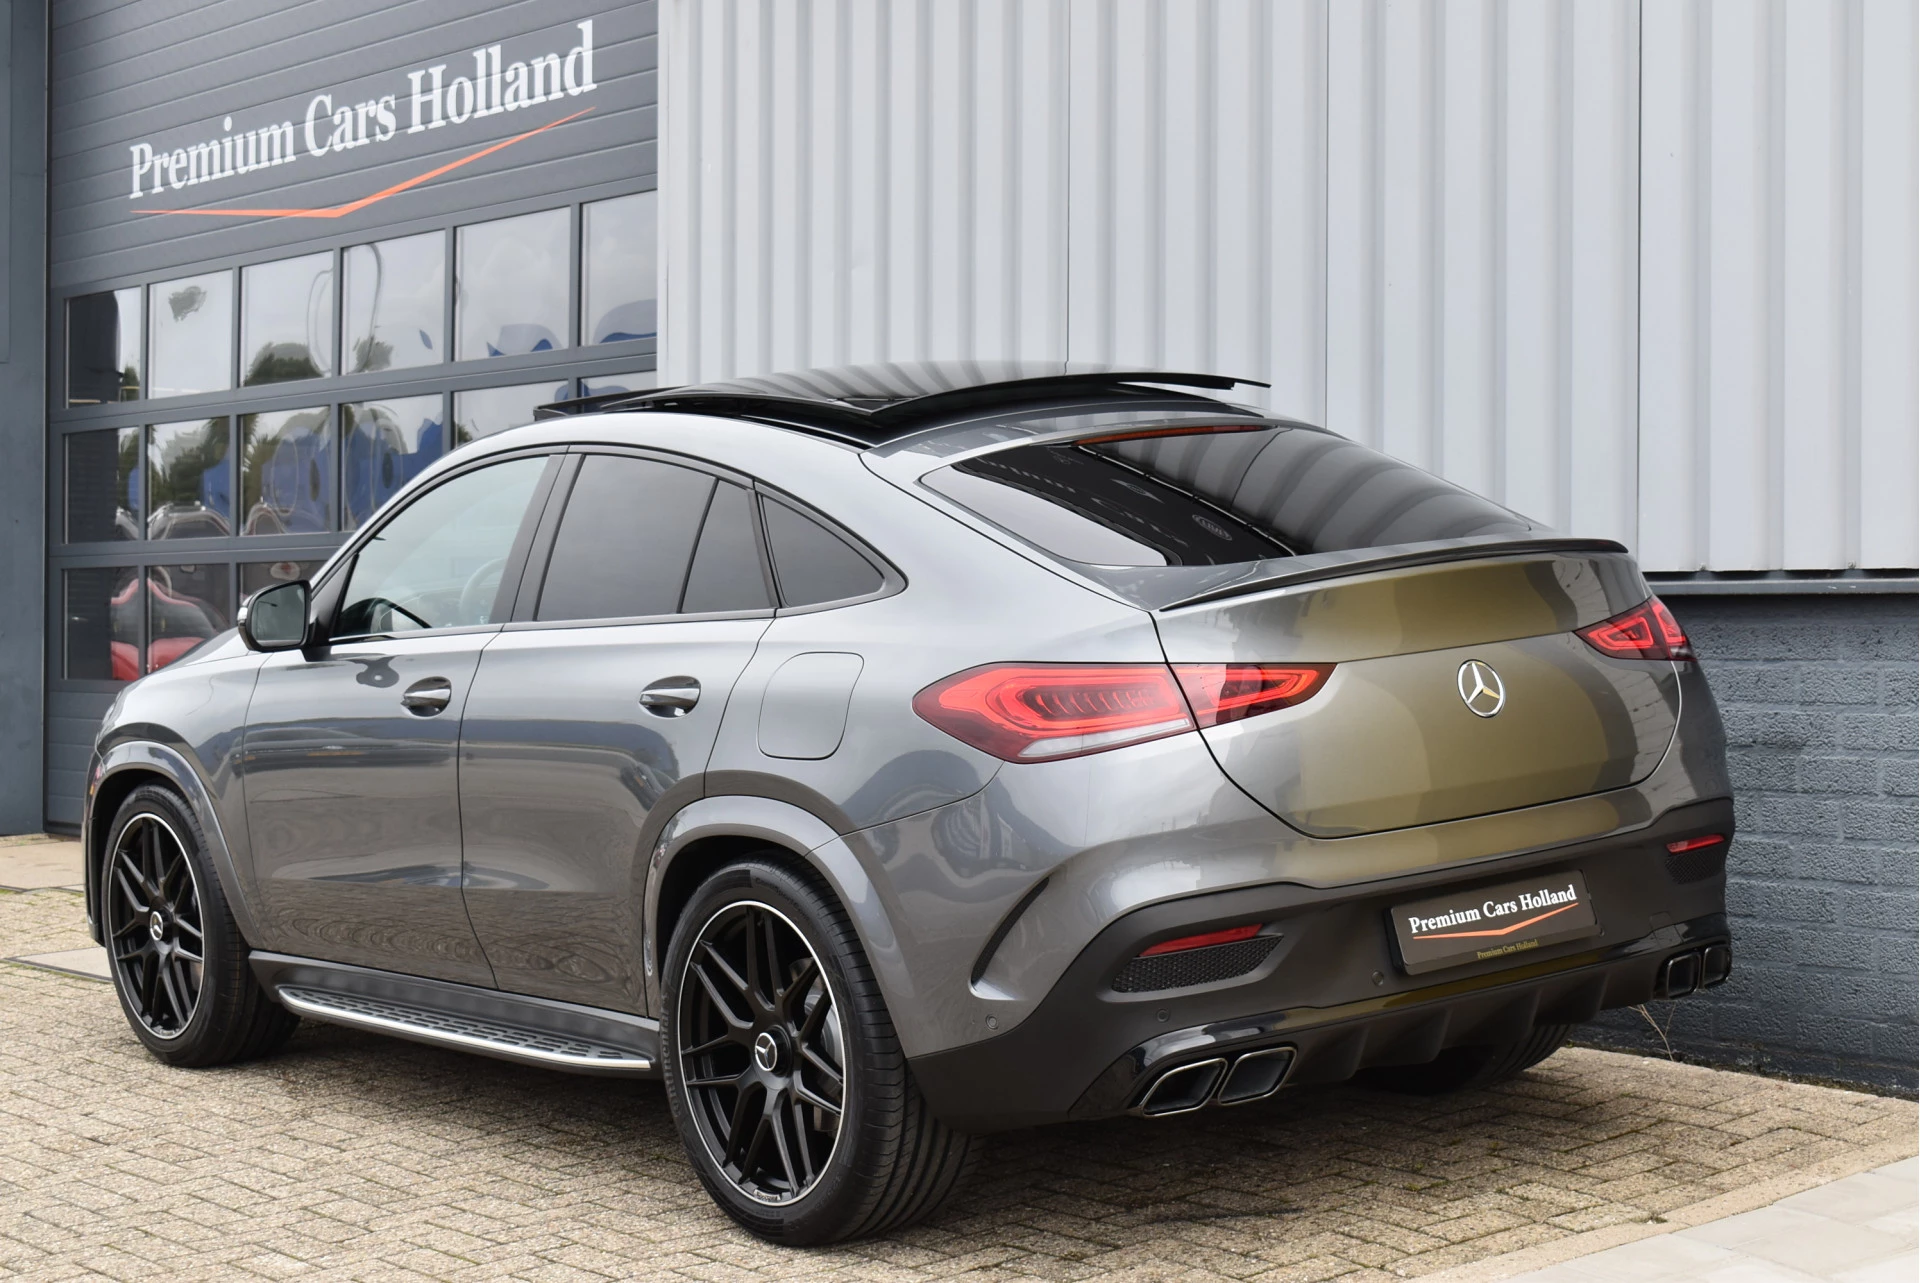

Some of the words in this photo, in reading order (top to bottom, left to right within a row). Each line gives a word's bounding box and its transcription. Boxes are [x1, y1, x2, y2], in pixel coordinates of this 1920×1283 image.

[129, 116, 297, 199] Premium
[304, 93, 396, 157] Cars
[407, 19, 598, 134] Holland
[1408, 909, 1481, 934] Premium
[1482, 900, 1517, 918] Cars
[1518, 884, 1577, 911] Holland
[1476, 947, 1503, 960] Premium
[1502, 945, 1516, 954] Cars
[1515, 938, 1538, 951] Holland
